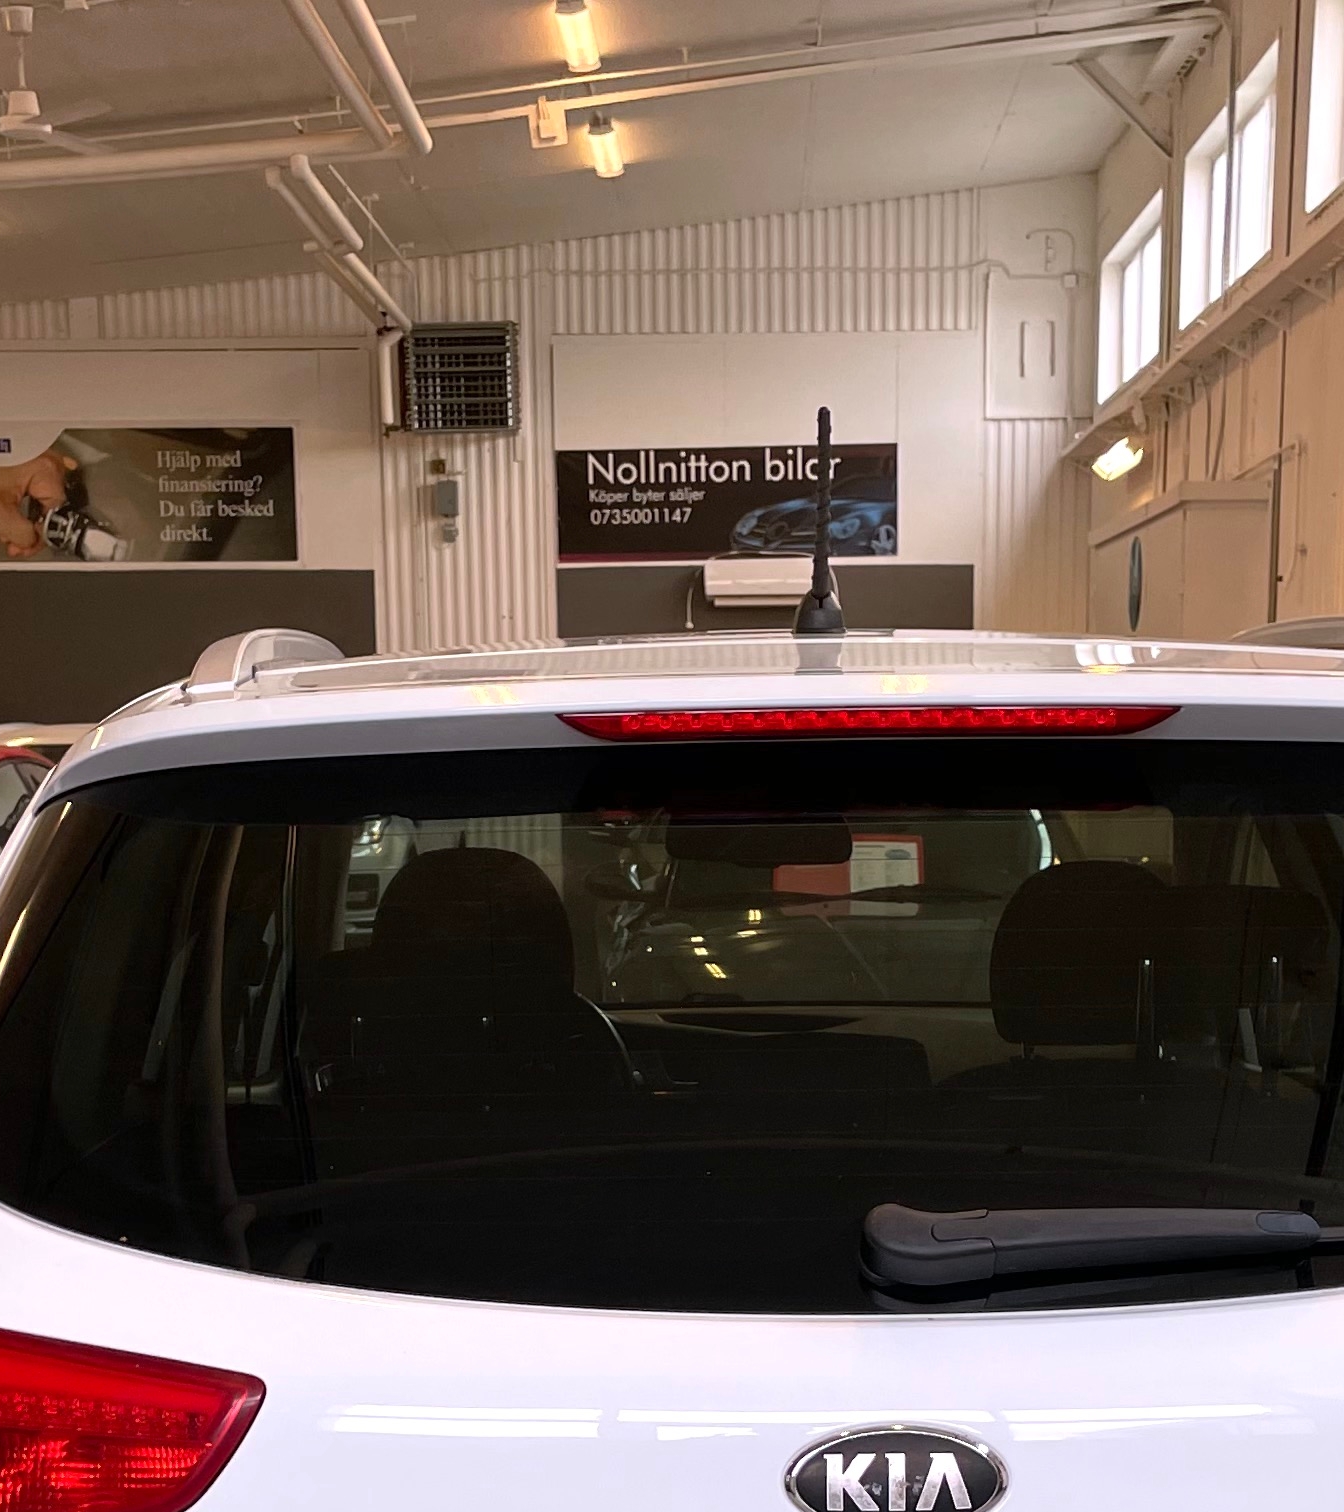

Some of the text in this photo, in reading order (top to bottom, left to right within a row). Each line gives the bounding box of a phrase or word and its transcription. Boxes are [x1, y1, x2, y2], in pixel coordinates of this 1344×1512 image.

[157, 448, 242, 473] Hjälp med
[587, 449, 752, 486] Nollnitton
[158, 474, 263, 497] finansiering?
[159, 499, 275, 517] Du får besked
[589, 507, 692, 526] 0735001147
[159, 524, 213, 542] direkt.
[822, 1451, 973, 1512] KIA
